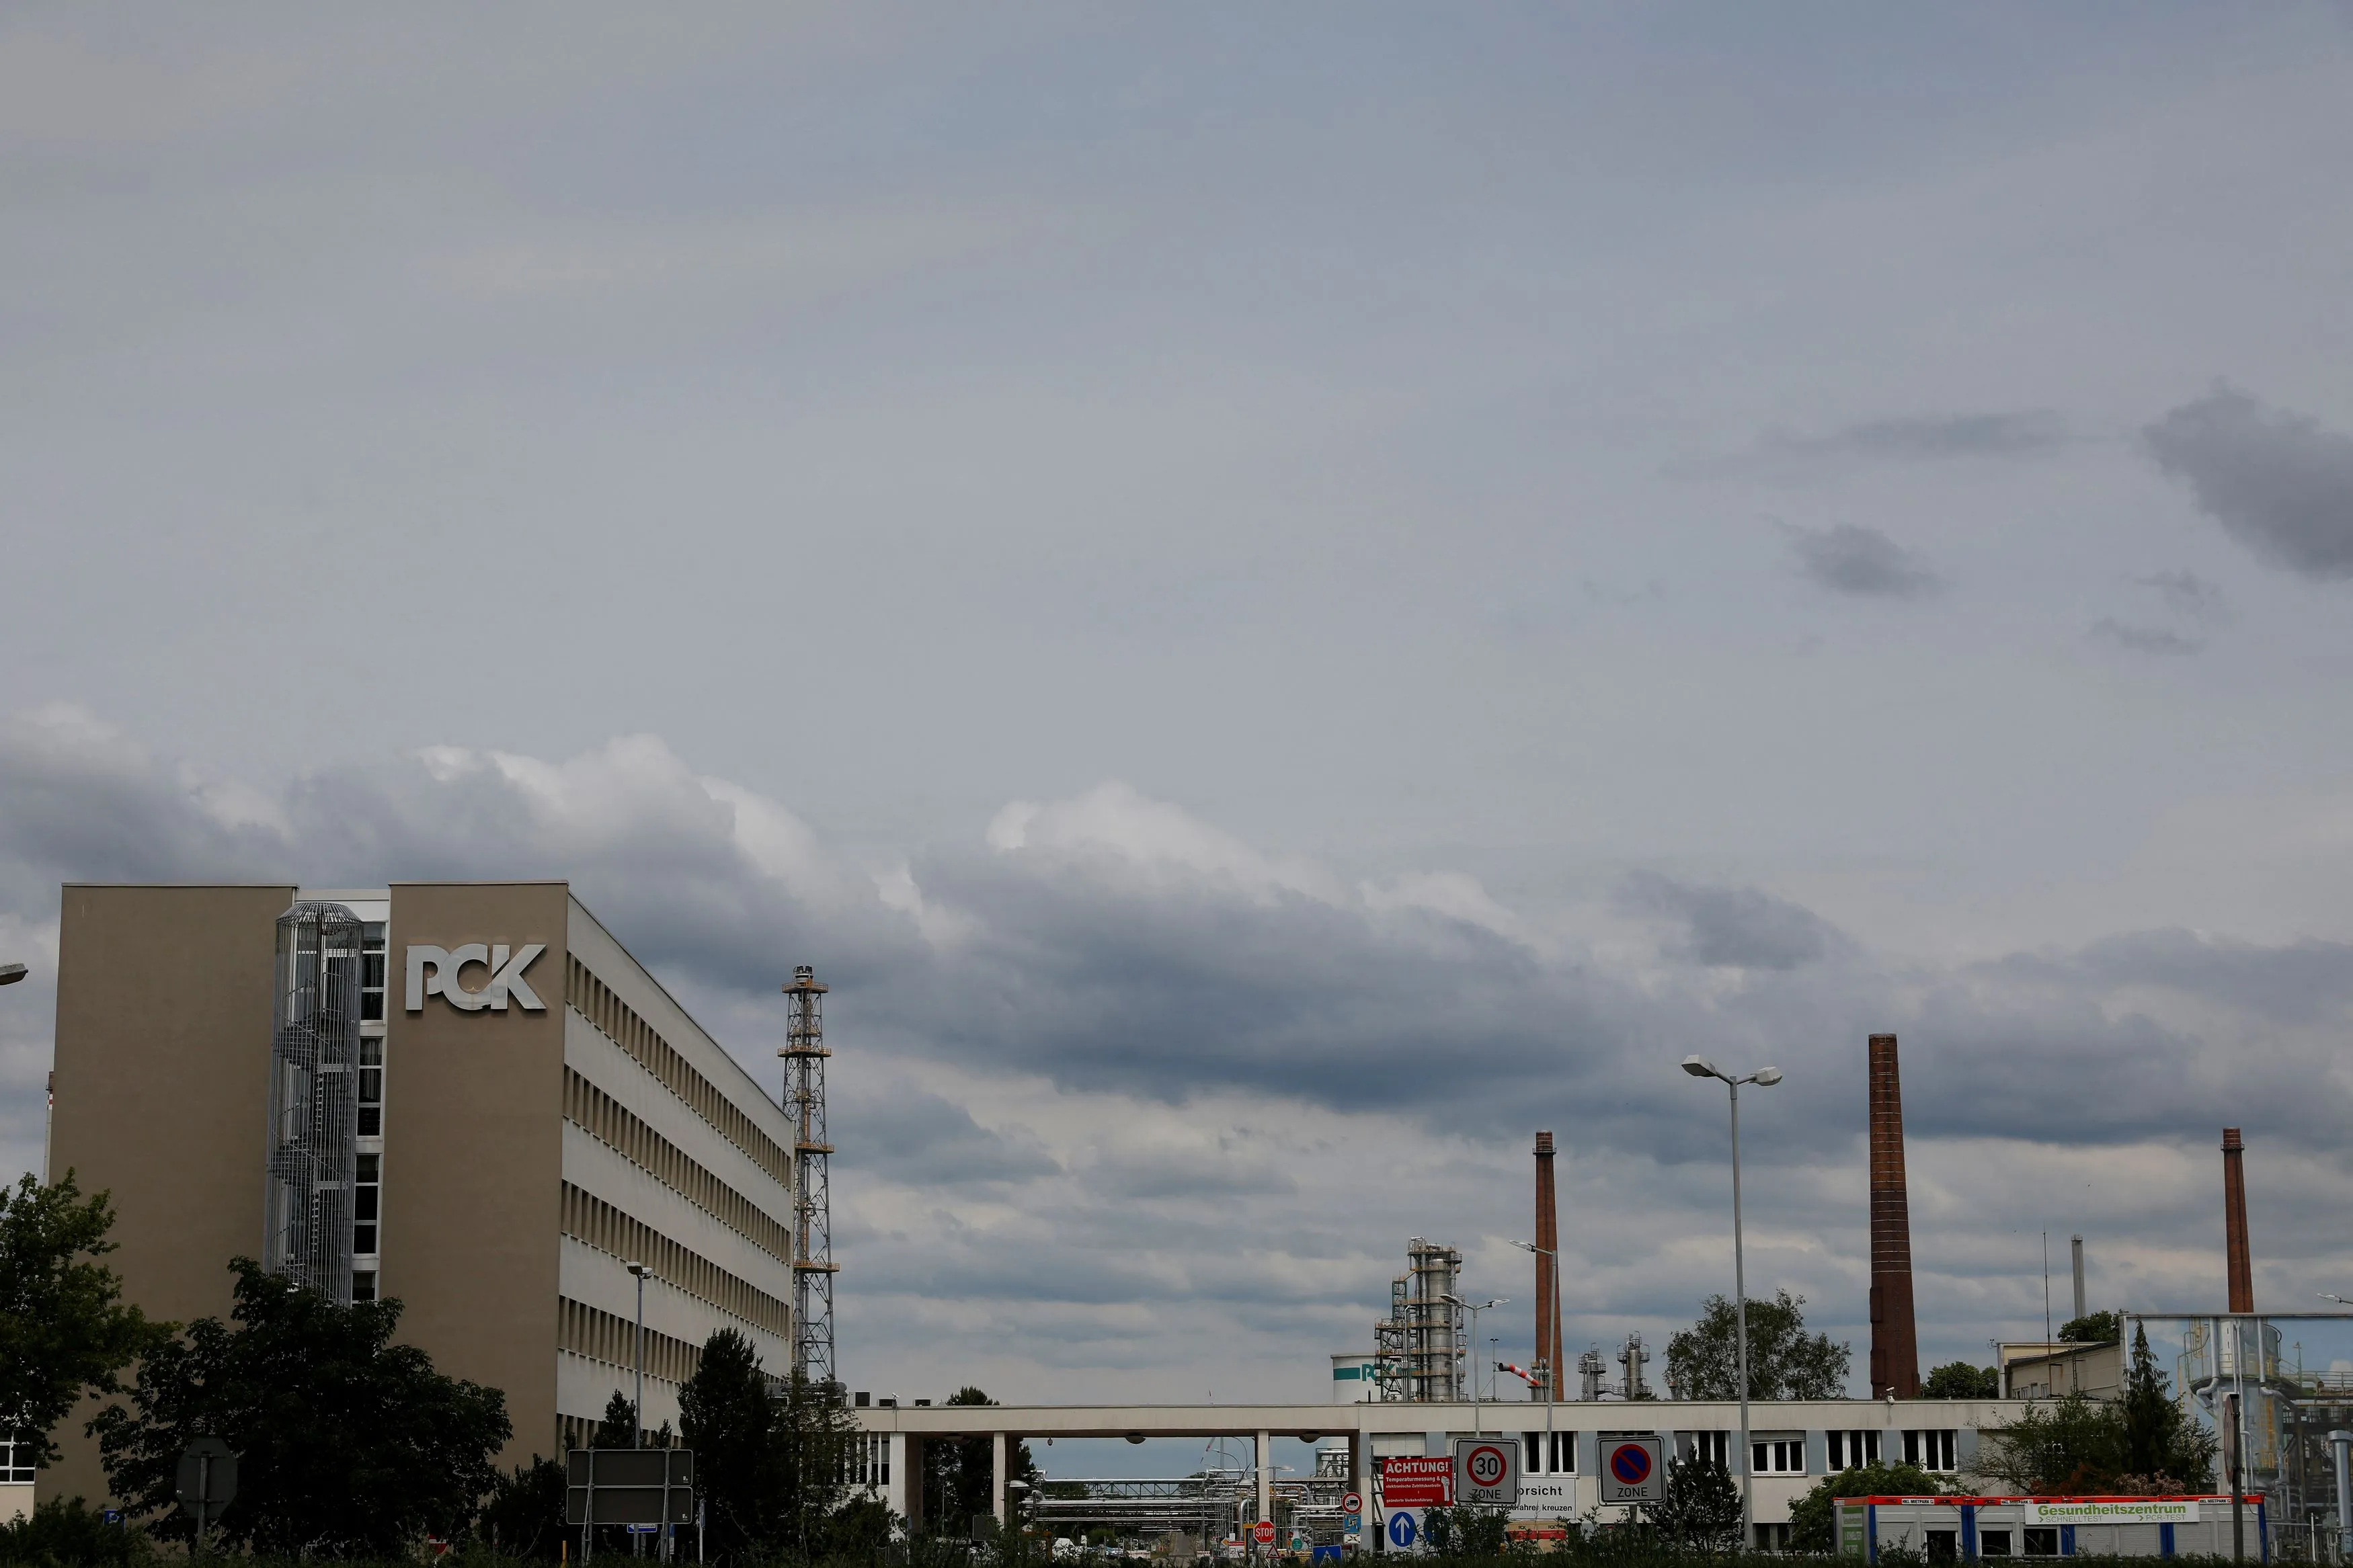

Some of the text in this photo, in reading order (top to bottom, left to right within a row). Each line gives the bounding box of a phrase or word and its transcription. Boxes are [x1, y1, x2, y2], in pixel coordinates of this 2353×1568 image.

[405, 943, 548, 1011] PCK
[1386, 1462, 1448, 1473] ACHTUNG!
[1475, 1456, 1498, 1476] 30
[1517, 1485, 1562, 1495] orsicht
[1617, 1487, 1648, 1497] ZONE
[2038, 1504, 2186, 1516] Gesundheitszentrum
[1256, 1528, 1274, 1537] STOP
